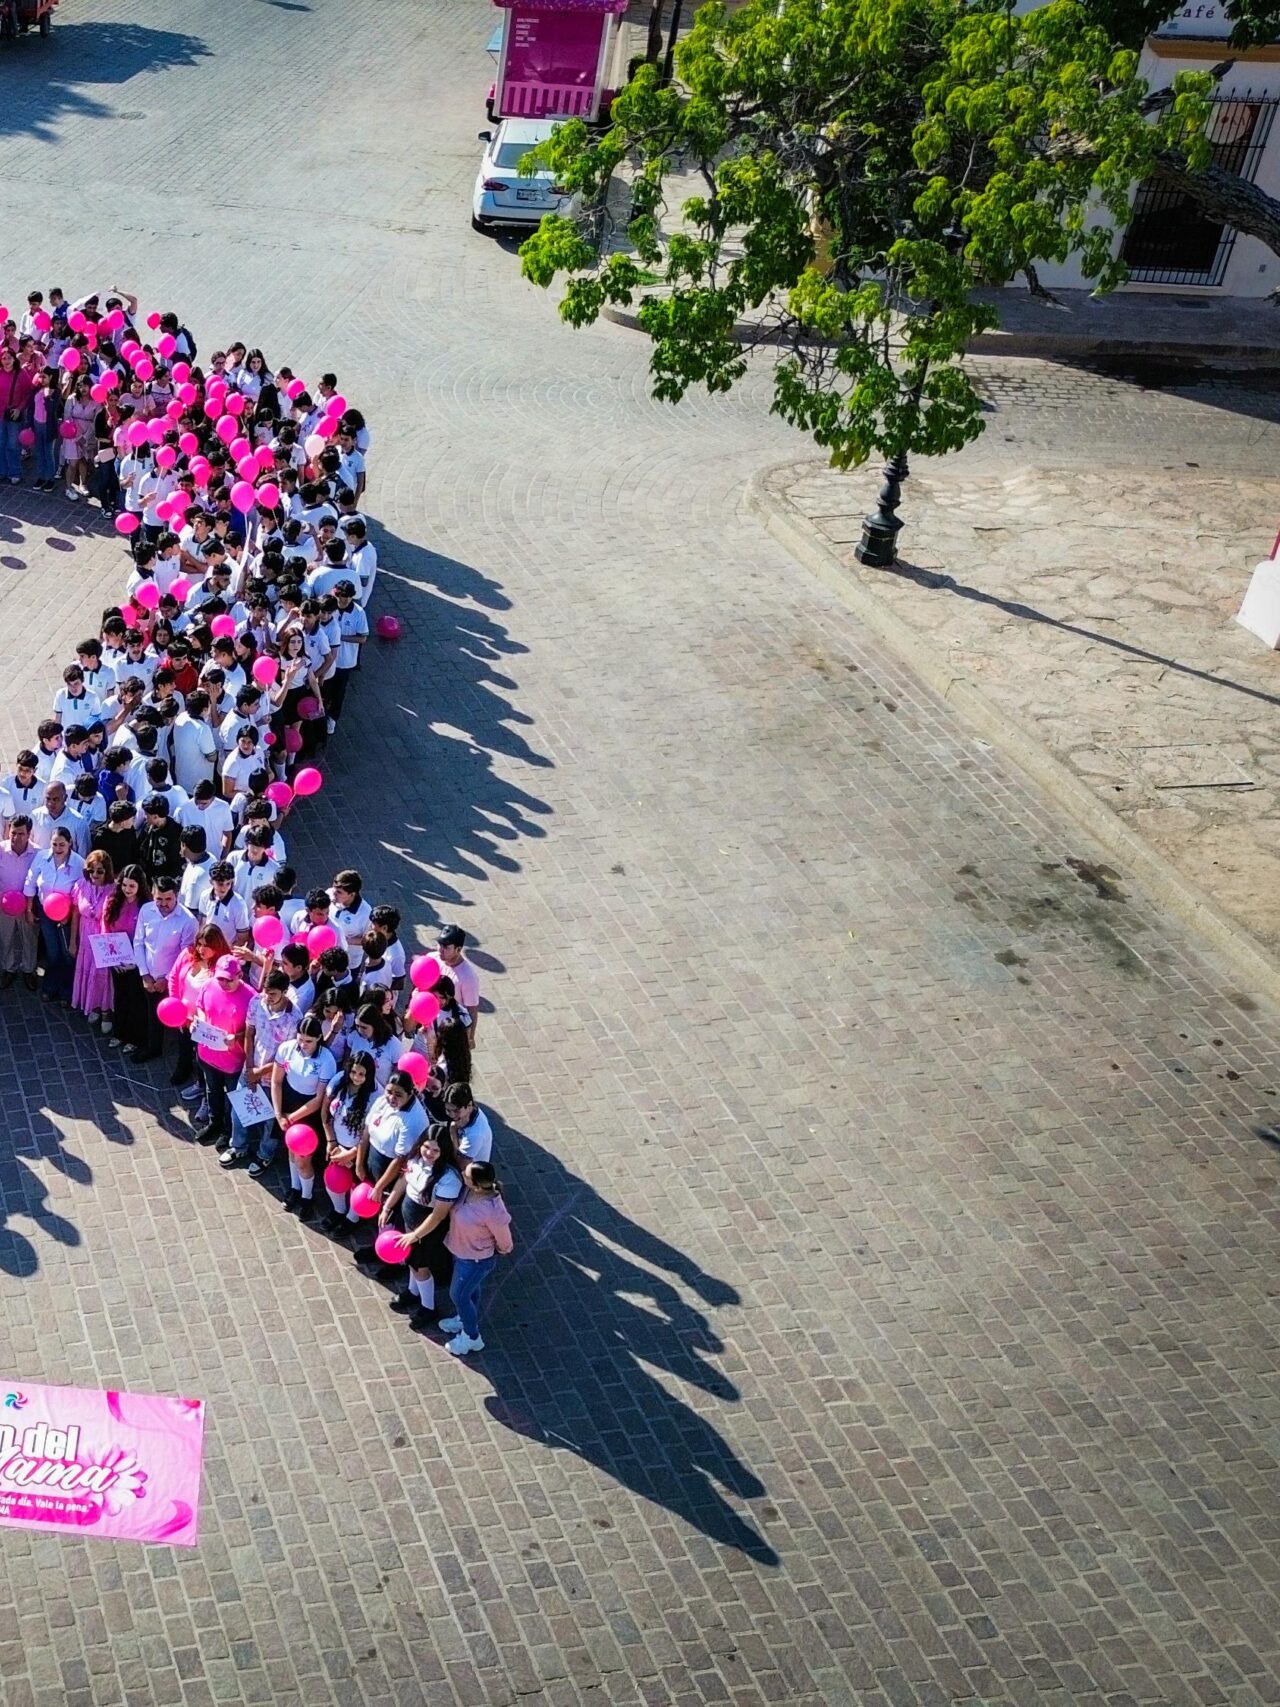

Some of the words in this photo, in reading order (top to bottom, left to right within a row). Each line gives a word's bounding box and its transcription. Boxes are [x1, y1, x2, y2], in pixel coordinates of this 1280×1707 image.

[23, 1421, 81, 1462] del
[36, 1498, 53, 1509] Vale
[55, 1500, 64, 1511] la
